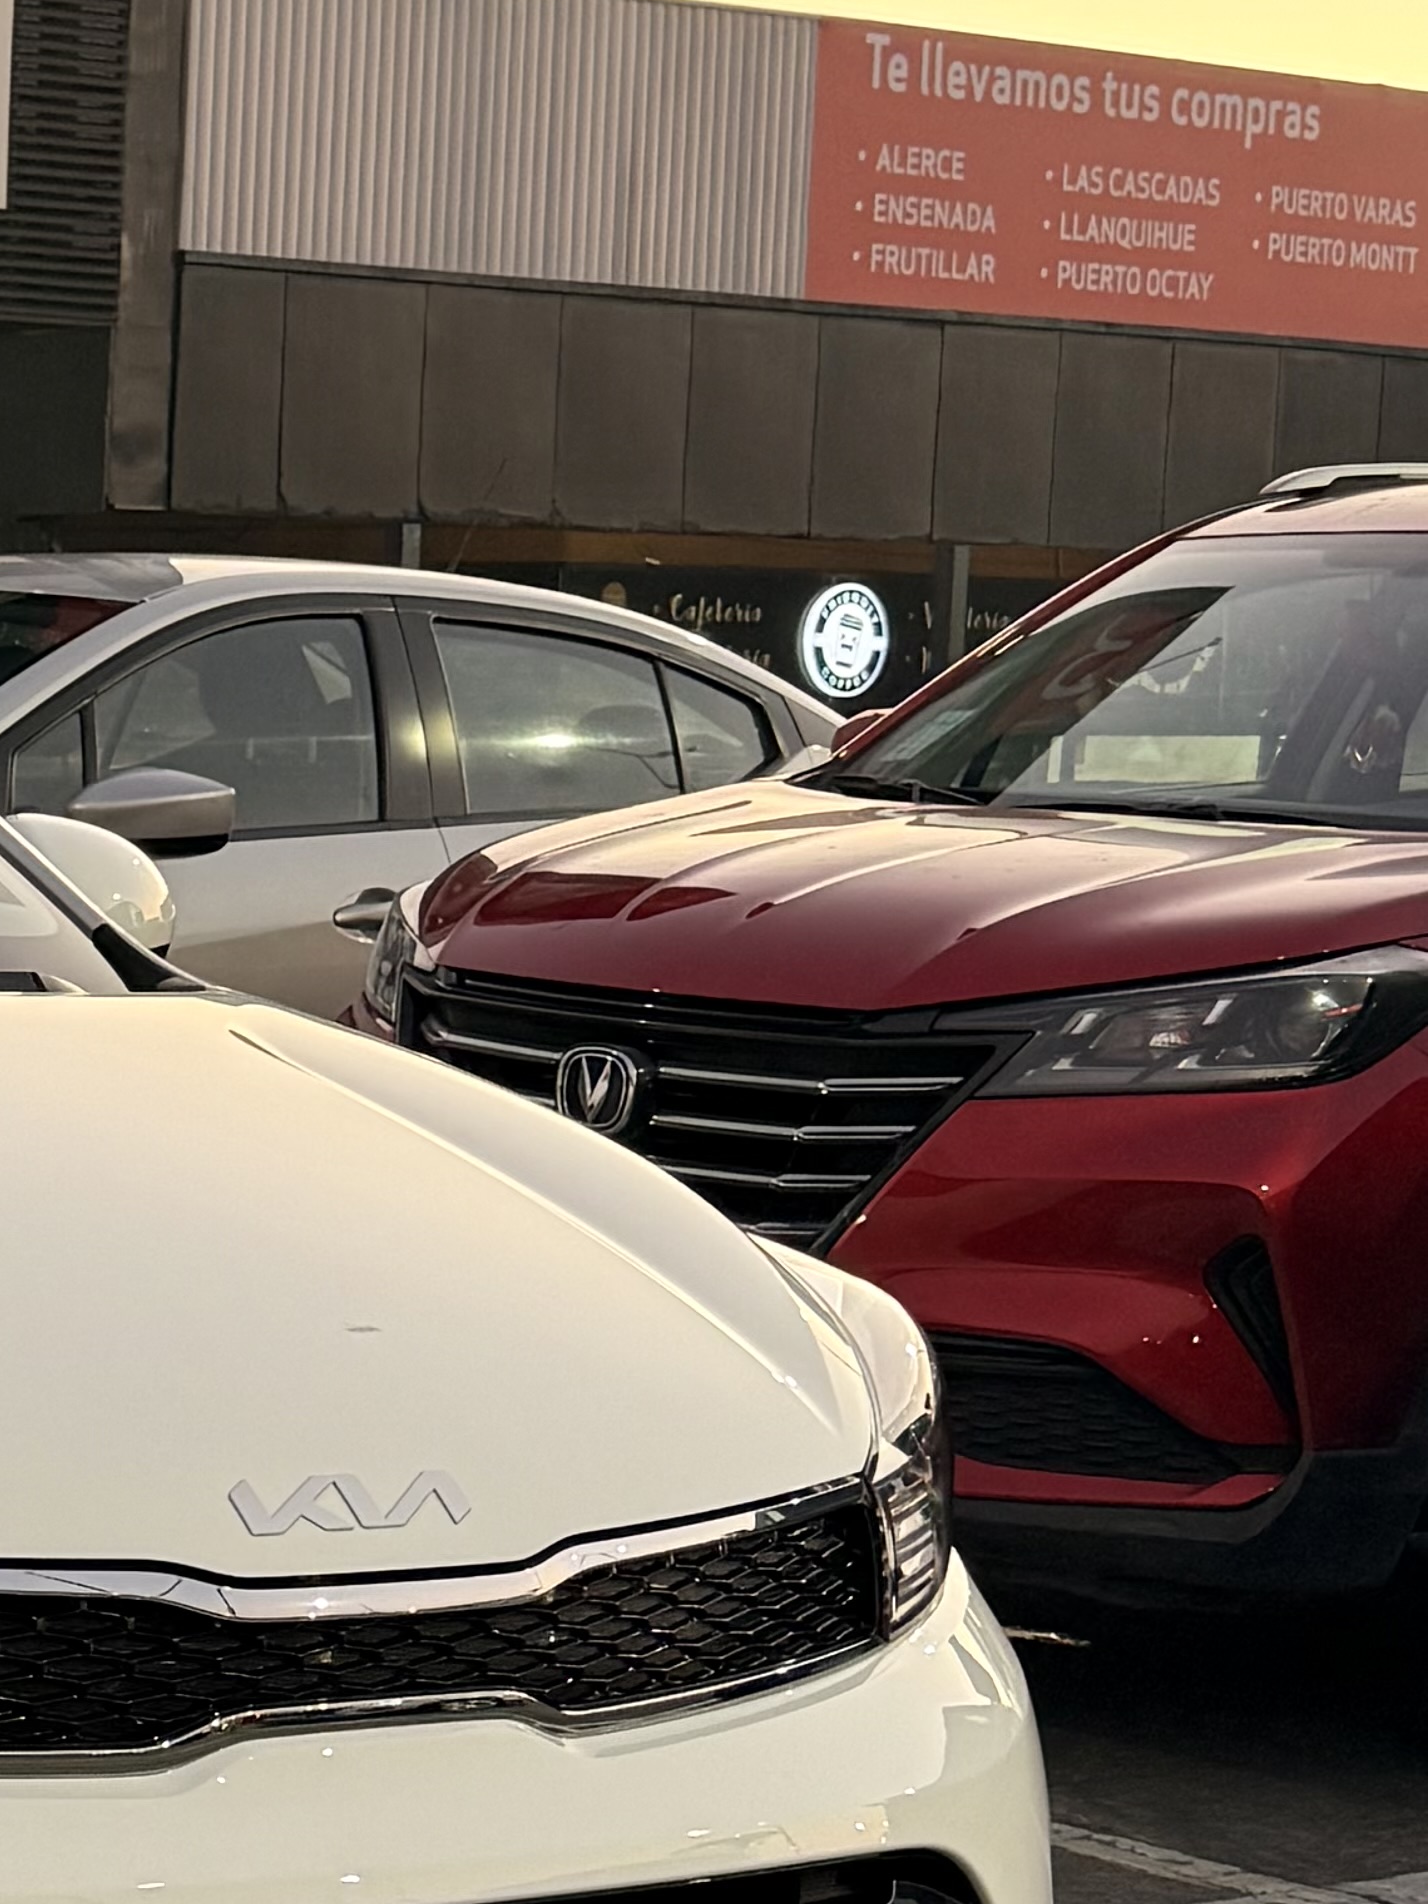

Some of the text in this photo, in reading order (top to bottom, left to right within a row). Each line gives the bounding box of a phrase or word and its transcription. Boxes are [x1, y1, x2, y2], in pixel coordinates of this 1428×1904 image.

[866, 33, 1321, 149] Te llevamos tus compras
[875, 143, 965, 180] ALERCE
[1062, 163, 1221, 207] LAS CASCADAS
[873, 192, 997, 234] ENSENADA
[1270, 185, 1417, 228] PUERTO VARAS
[1059, 211, 1197, 252] LLANQUIHUE
[870, 243, 996, 284] FRUTILLAR
[1267, 232, 1419, 274] PUERTO MONTT
[1057, 260, 1214, 301] PUERTO OCTAY
[227, 1470, 472, 1537] KIA
